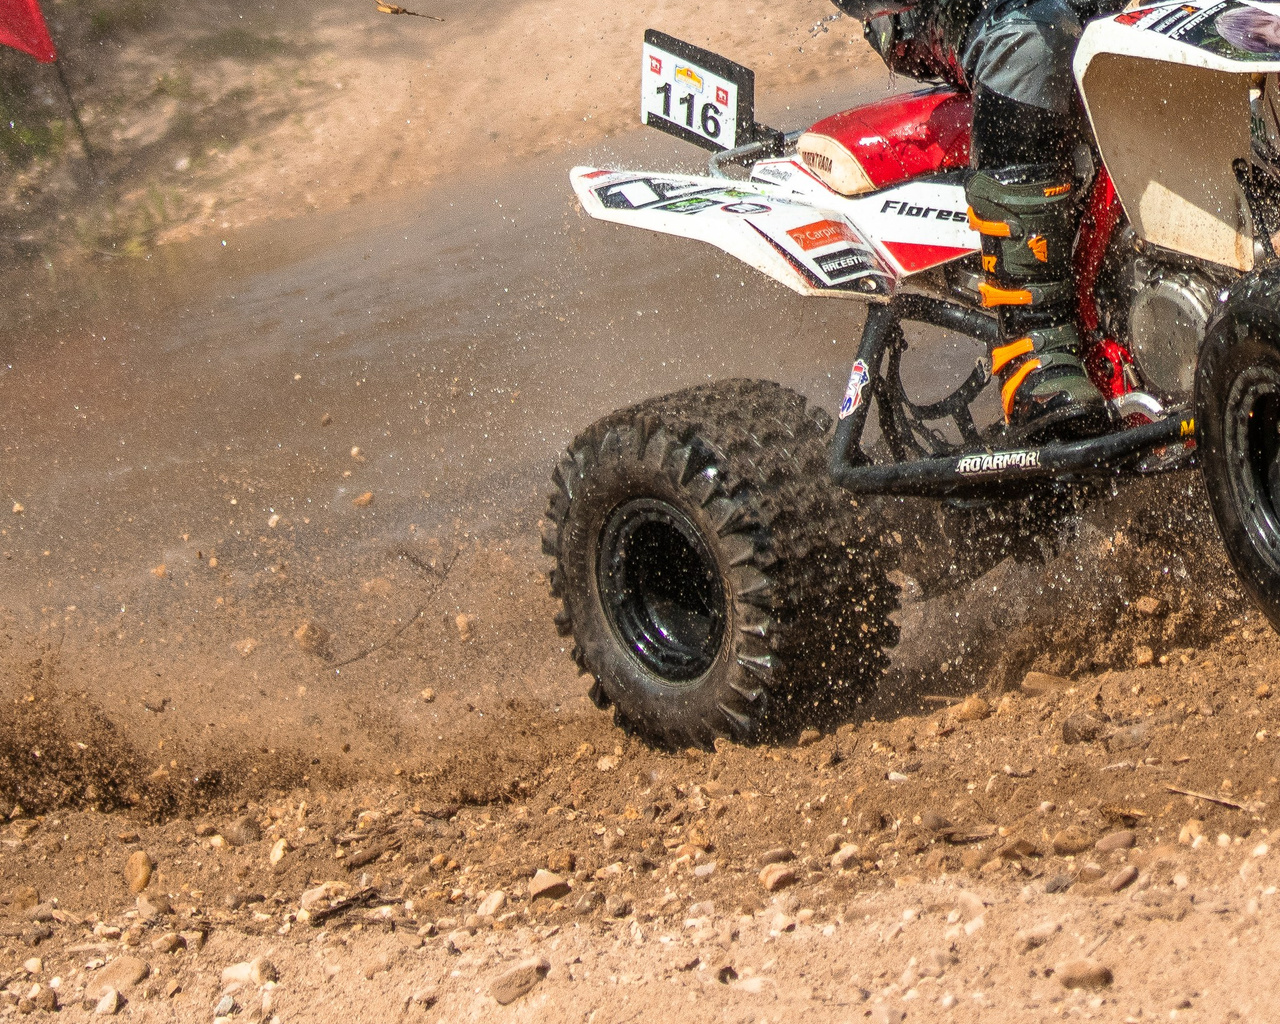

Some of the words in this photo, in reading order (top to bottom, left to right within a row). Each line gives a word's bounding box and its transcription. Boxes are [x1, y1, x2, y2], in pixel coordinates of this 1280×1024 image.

[1172, 2, 1227, 40] Francisco
[656, 81, 721, 140] 116
[880, 199, 969, 224] Flores
[981, 449, 1038, 471] ARMOR
